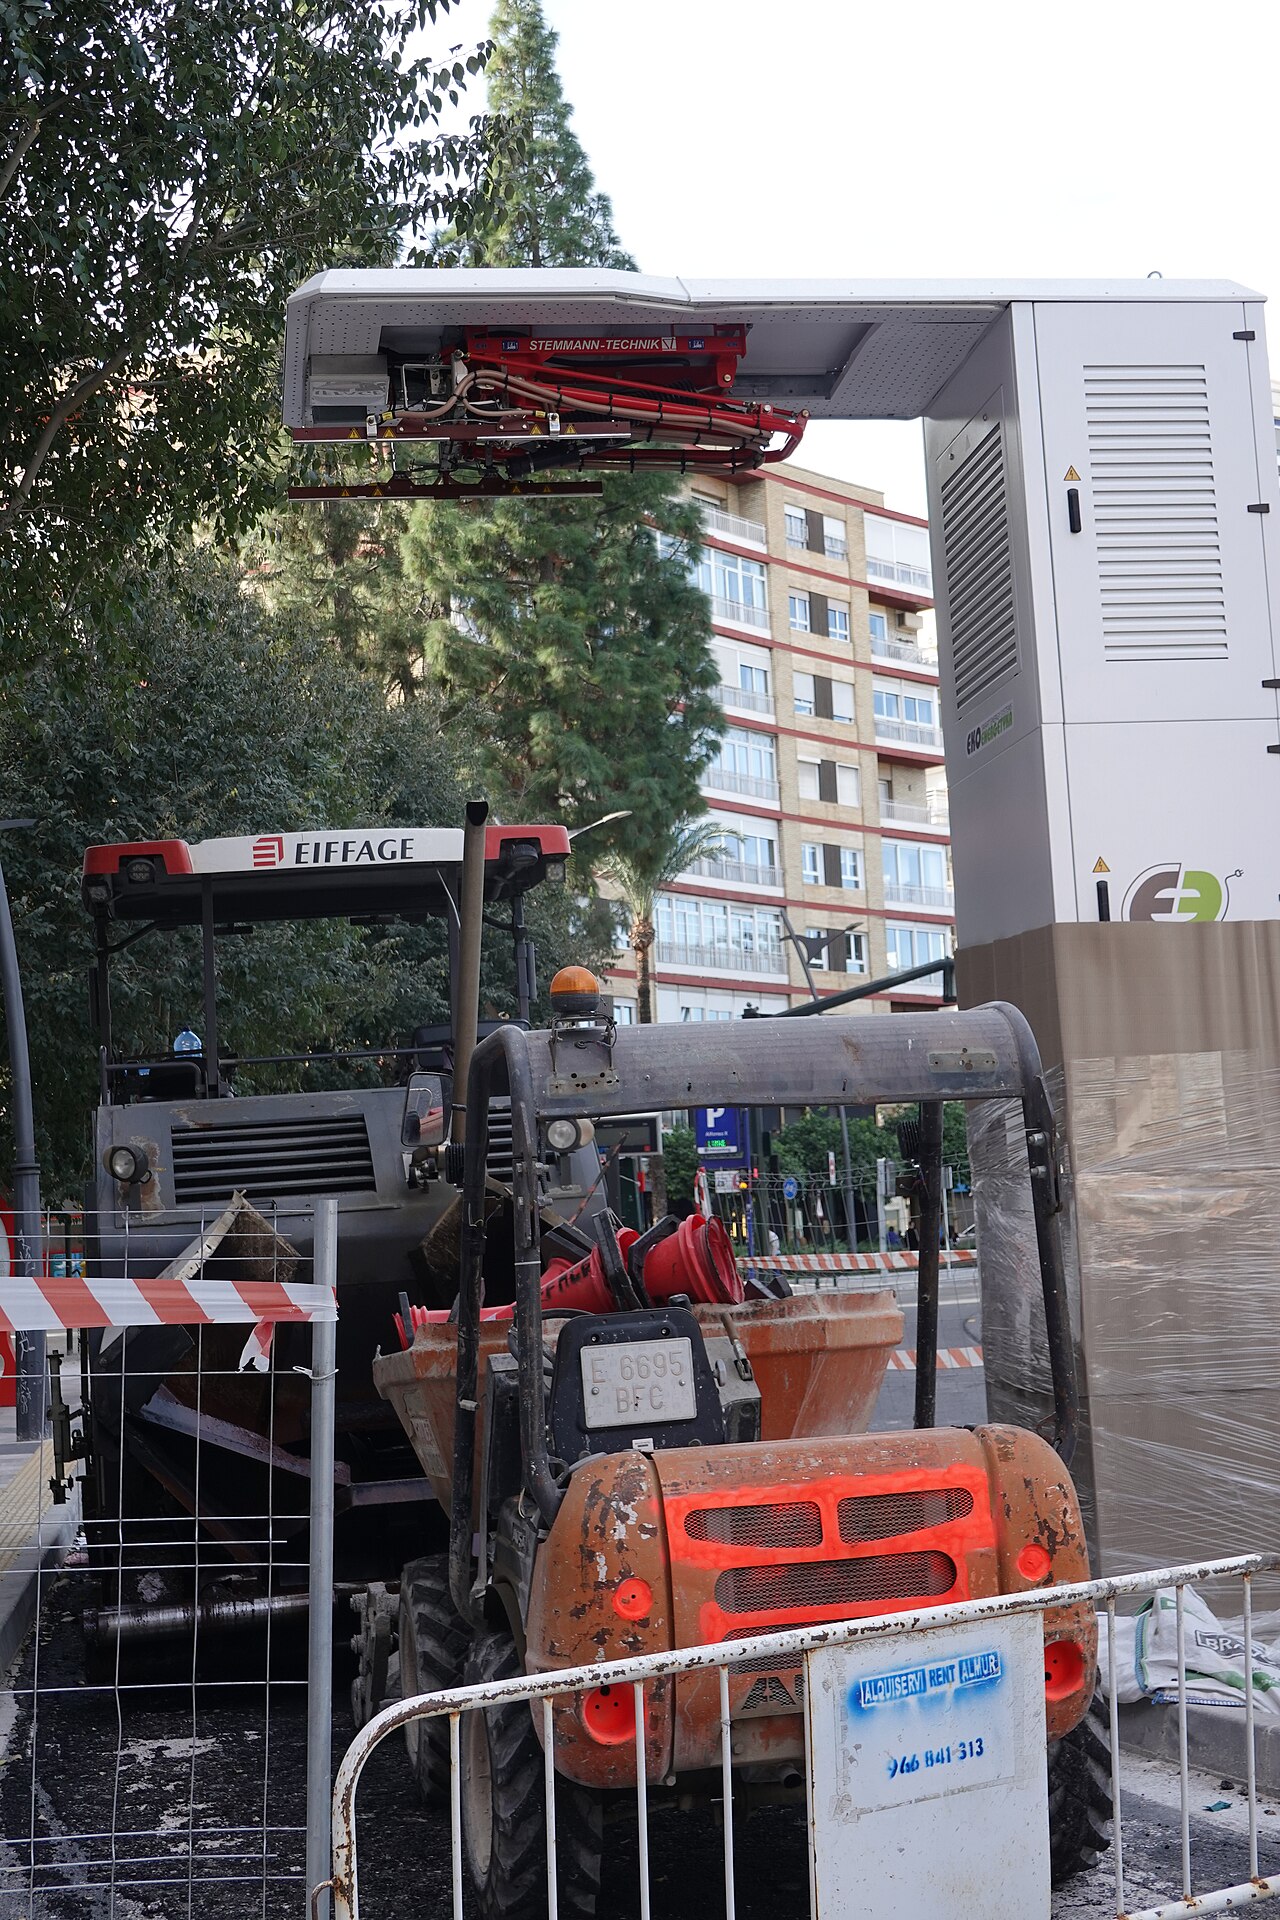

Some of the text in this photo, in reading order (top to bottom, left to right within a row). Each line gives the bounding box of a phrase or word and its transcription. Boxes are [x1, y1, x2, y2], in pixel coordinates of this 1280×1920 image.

[529, 339, 661, 351] STEMMANN-TECHNIK
[295, 838, 415, 865] EIFFAGE
[706, 1107, 726, 1128] P
[591, 1351, 685, 1384] E 6695
[615, 1385, 664, 1413] BFC
[864, 1654, 998, 1704] ALQUISERVI RENT ALMUR
[887, 1753, 921, 1780] 966
[958, 1737, 985, 1760] 313
